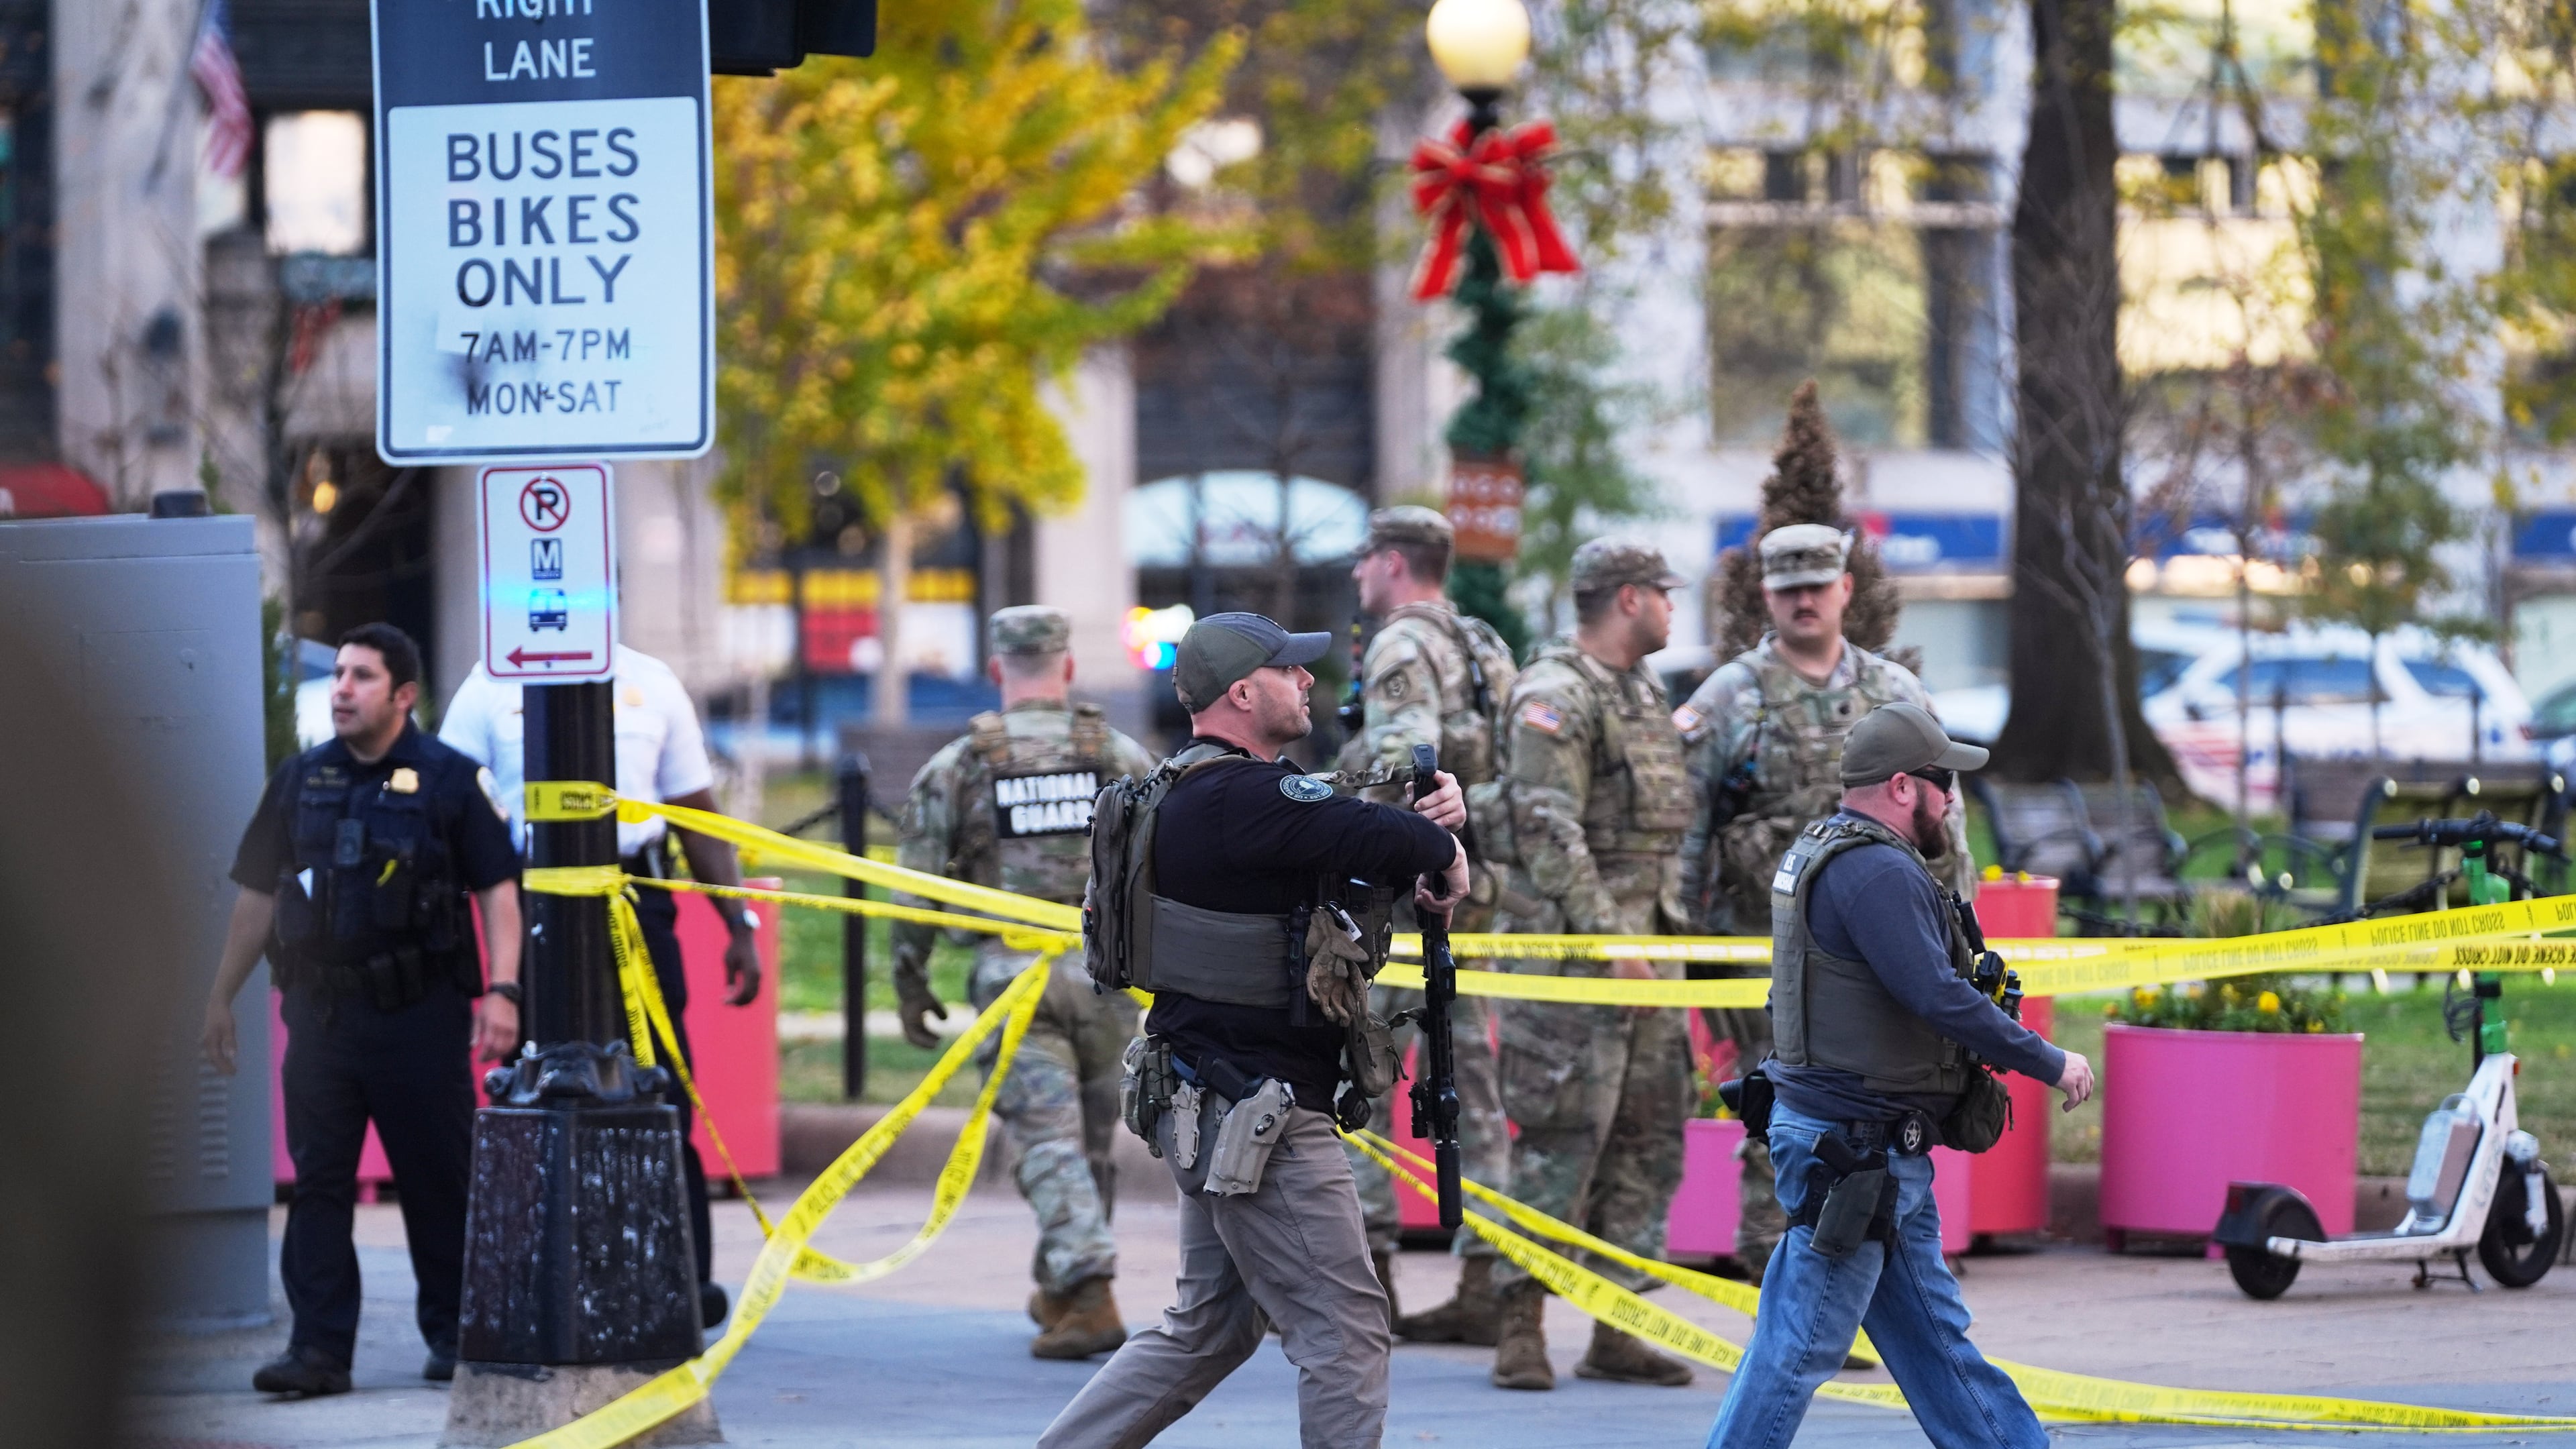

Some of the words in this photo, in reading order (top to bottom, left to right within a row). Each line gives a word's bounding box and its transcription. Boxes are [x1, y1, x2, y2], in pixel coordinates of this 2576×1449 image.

[484, 38, 596, 81] LANE
[447, 127, 639, 182] BUSES
[448, 193, 640, 247] BIKES
[456, 254, 633, 307] ONLY
[460, 328, 631, 364] 7AM-7PM
[466, 380, 623, 416] MON-SAT
